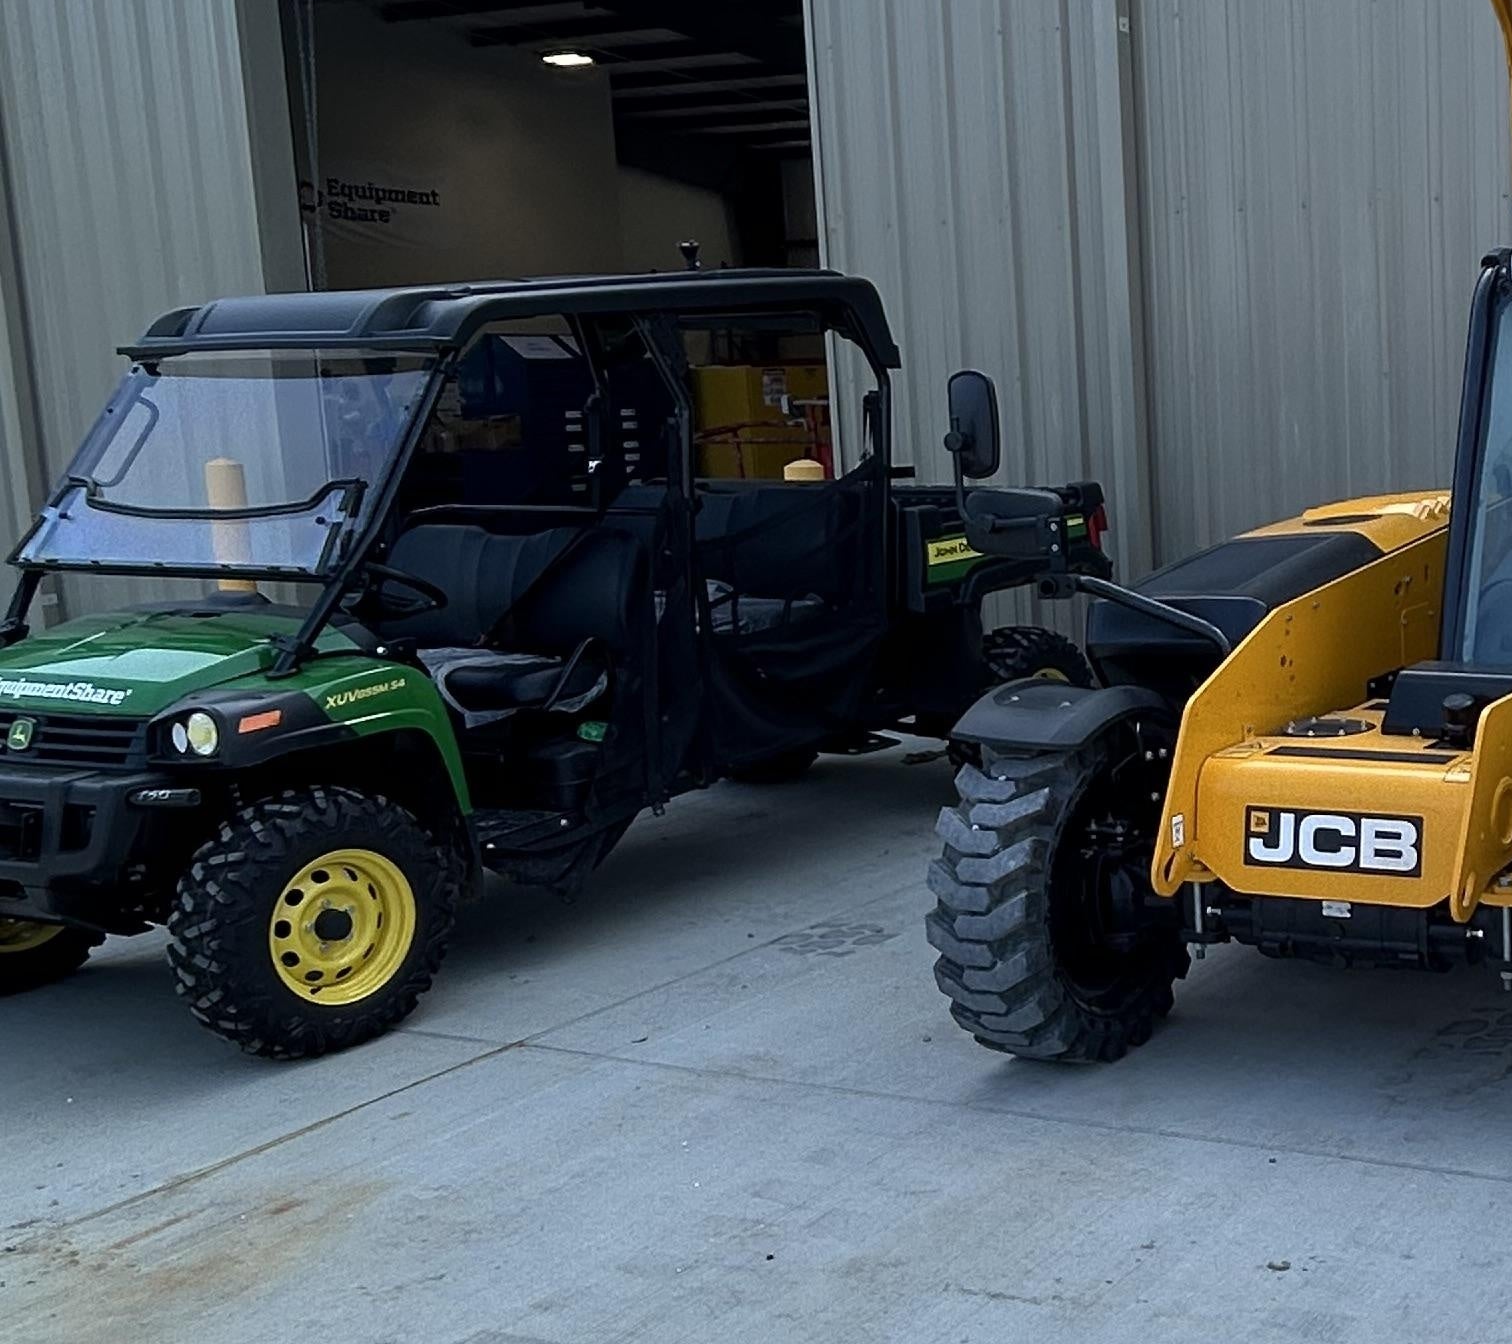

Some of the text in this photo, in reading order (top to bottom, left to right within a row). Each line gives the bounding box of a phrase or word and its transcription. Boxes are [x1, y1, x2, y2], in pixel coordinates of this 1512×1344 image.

[326, 177, 440, 206] Equipment
[328, 200, 391, 223] Share
[934, 544, 958, 558] JOHN
[1249, 812, 1418, 872] JCB
